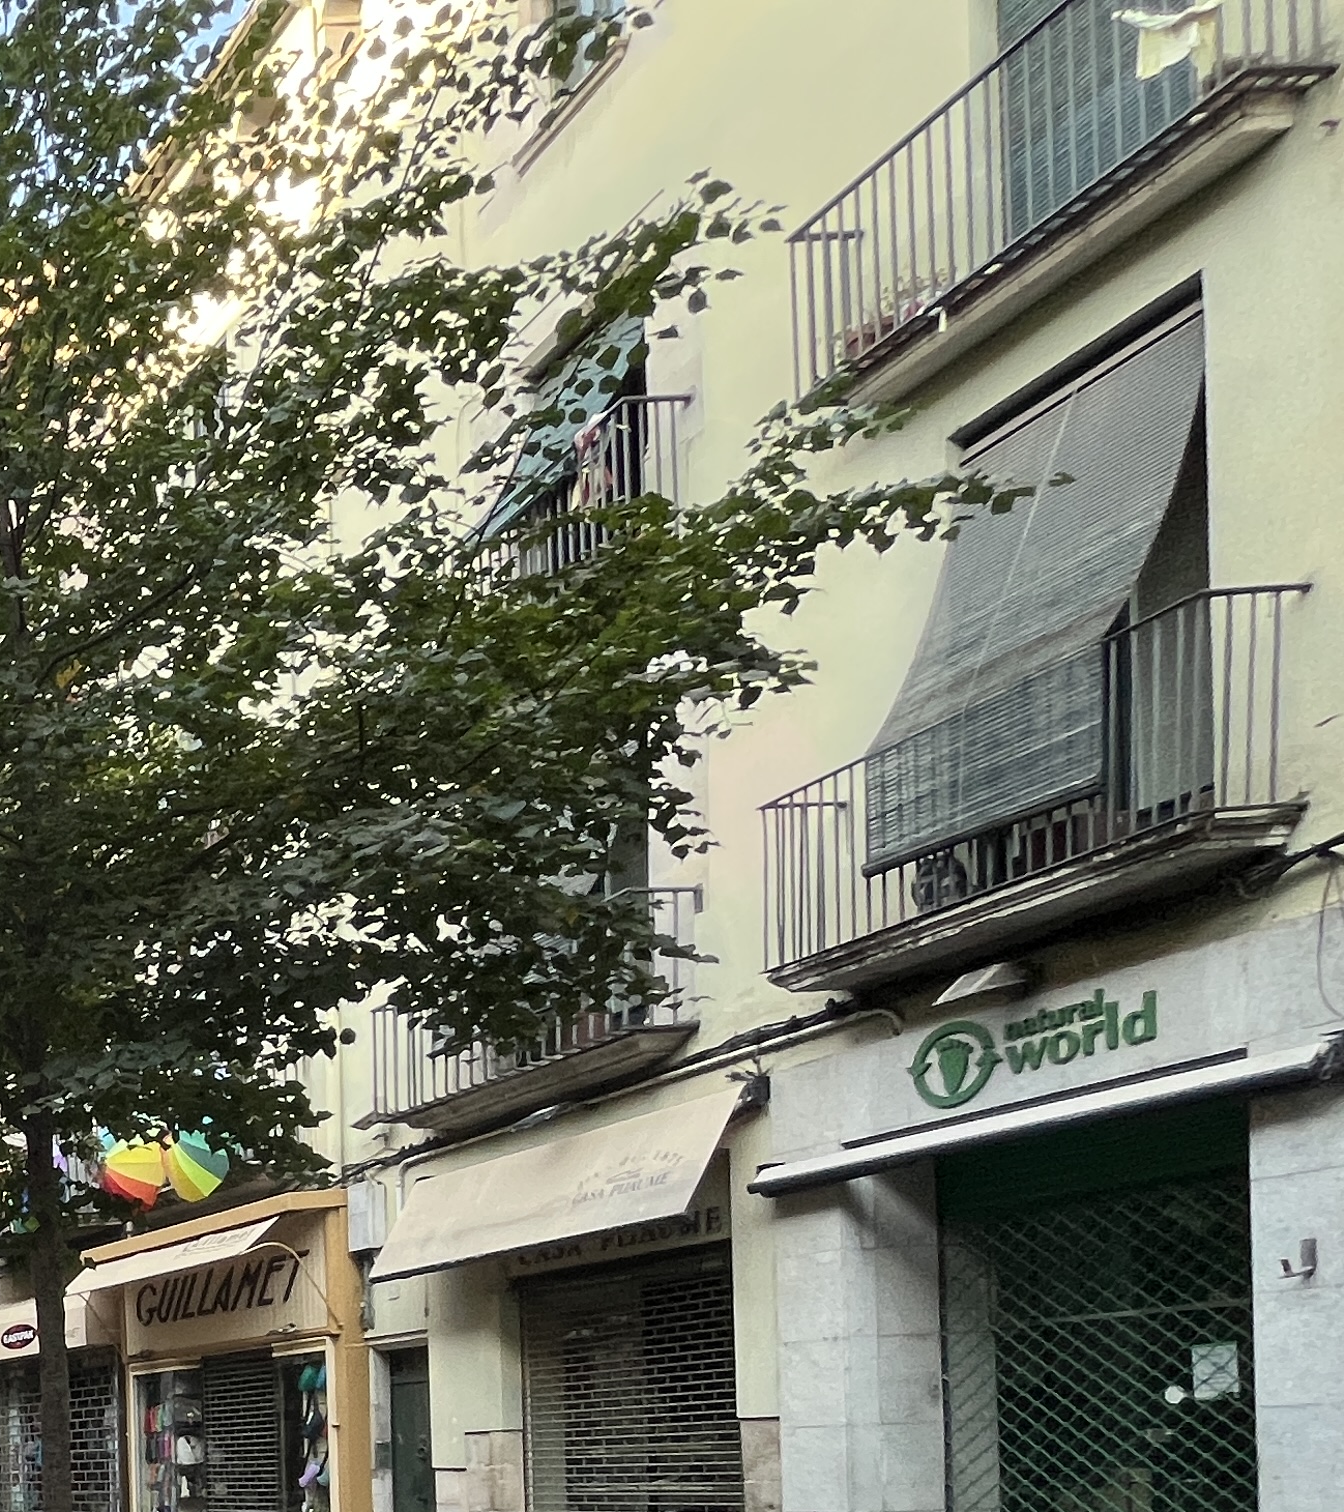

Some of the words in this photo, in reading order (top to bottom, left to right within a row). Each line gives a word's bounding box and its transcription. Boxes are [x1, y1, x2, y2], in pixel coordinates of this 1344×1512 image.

[1003, 988, 1105, 1041] natural
[1004, 989, 1158, 1075] world
[135, 1248, 311, 1327] GUILLAMET
[2, 1329, 35, 1344] EASTPAK
